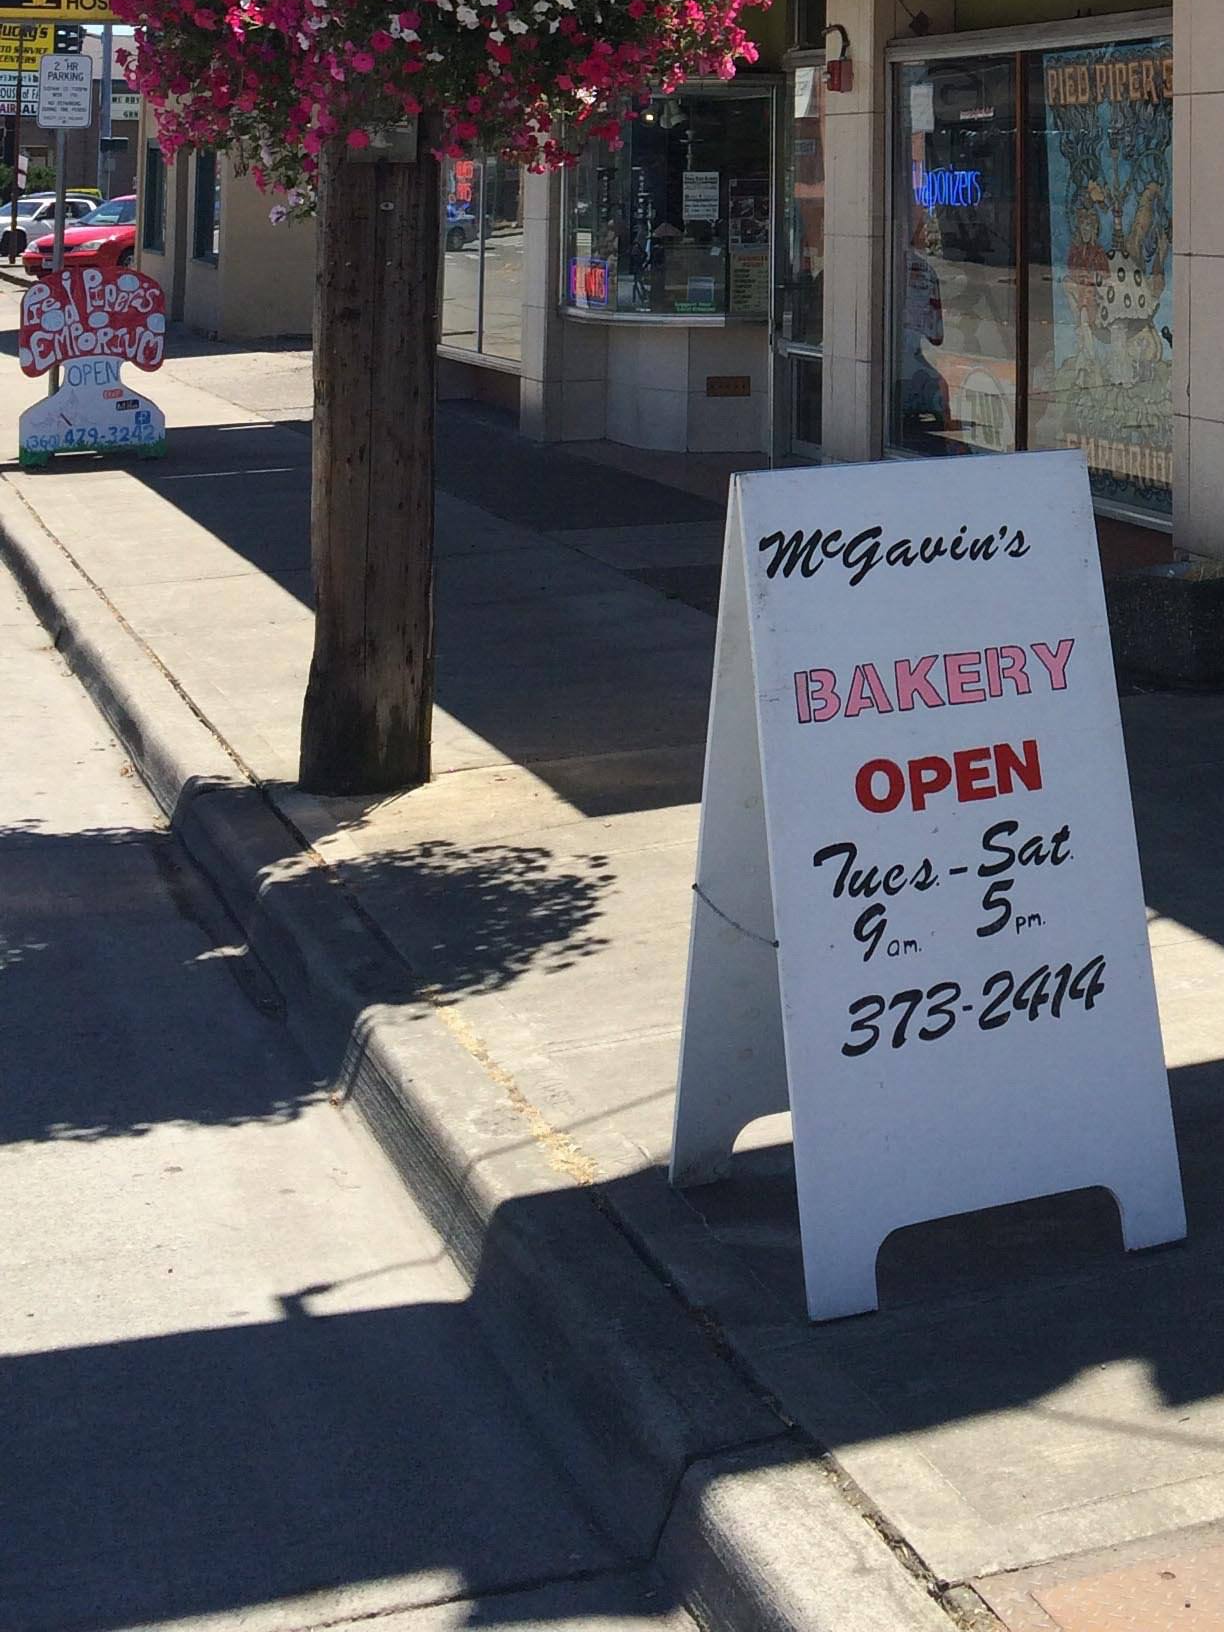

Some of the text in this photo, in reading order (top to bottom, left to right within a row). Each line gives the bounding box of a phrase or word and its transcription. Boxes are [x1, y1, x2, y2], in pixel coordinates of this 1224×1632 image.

[48, 72, 84, 81] PARKING
[54, 61, 79, 70] 2 HR
[912, 167, 982, 209] Vaporizers
[30, 323, 164, 370] EMPORIUM
[68, 361, 120, 387] OPEN
[758, 524, 1031, 586] McGavin's
[793, 638, 1075, 724] BAKERY
[855, 739, 1043, 814] OPEN
[841, 954, 1106, 1058] 373-2414
